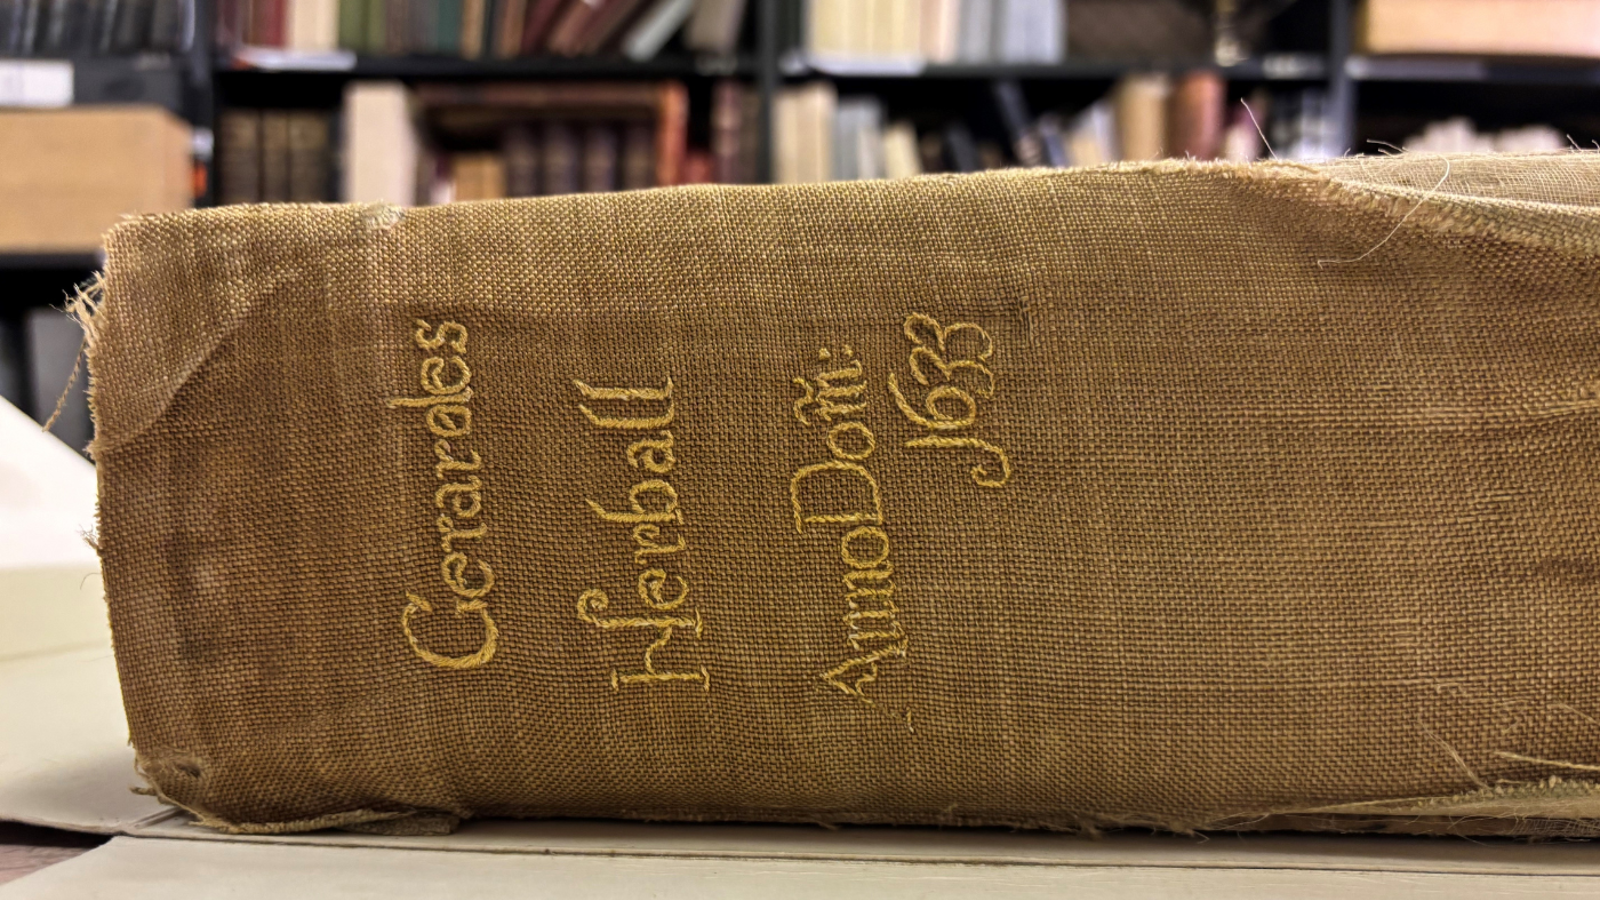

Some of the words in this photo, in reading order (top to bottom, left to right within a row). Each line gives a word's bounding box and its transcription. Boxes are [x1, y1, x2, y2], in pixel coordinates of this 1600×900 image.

[385, 319, 499, 670] Gerardes
[572, 375, 710, 692] Herball
[815, 525, 915, 734] Anno
